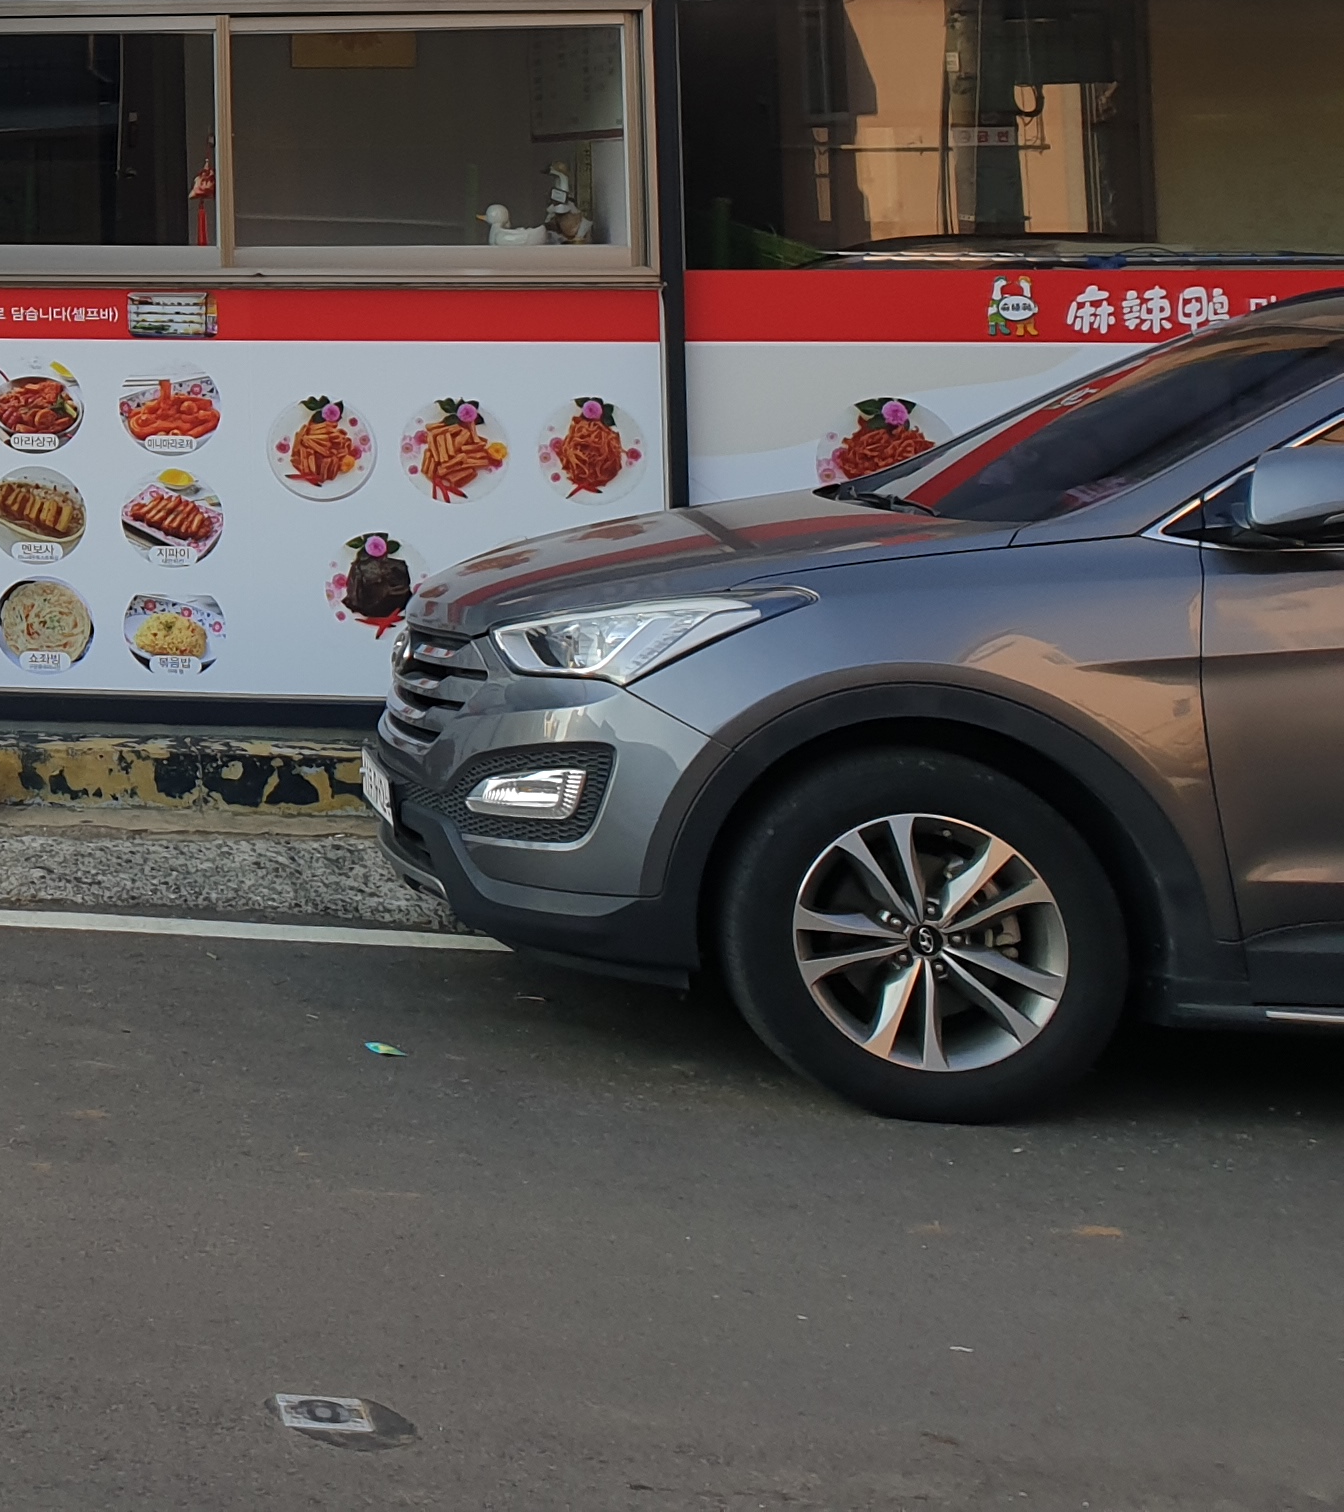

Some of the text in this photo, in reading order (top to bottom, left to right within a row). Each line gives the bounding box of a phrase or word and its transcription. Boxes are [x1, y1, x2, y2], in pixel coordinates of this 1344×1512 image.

[1066, 285, 1230, 334] 麻辣鸭
[156, 547, 190, 559] 지파이
